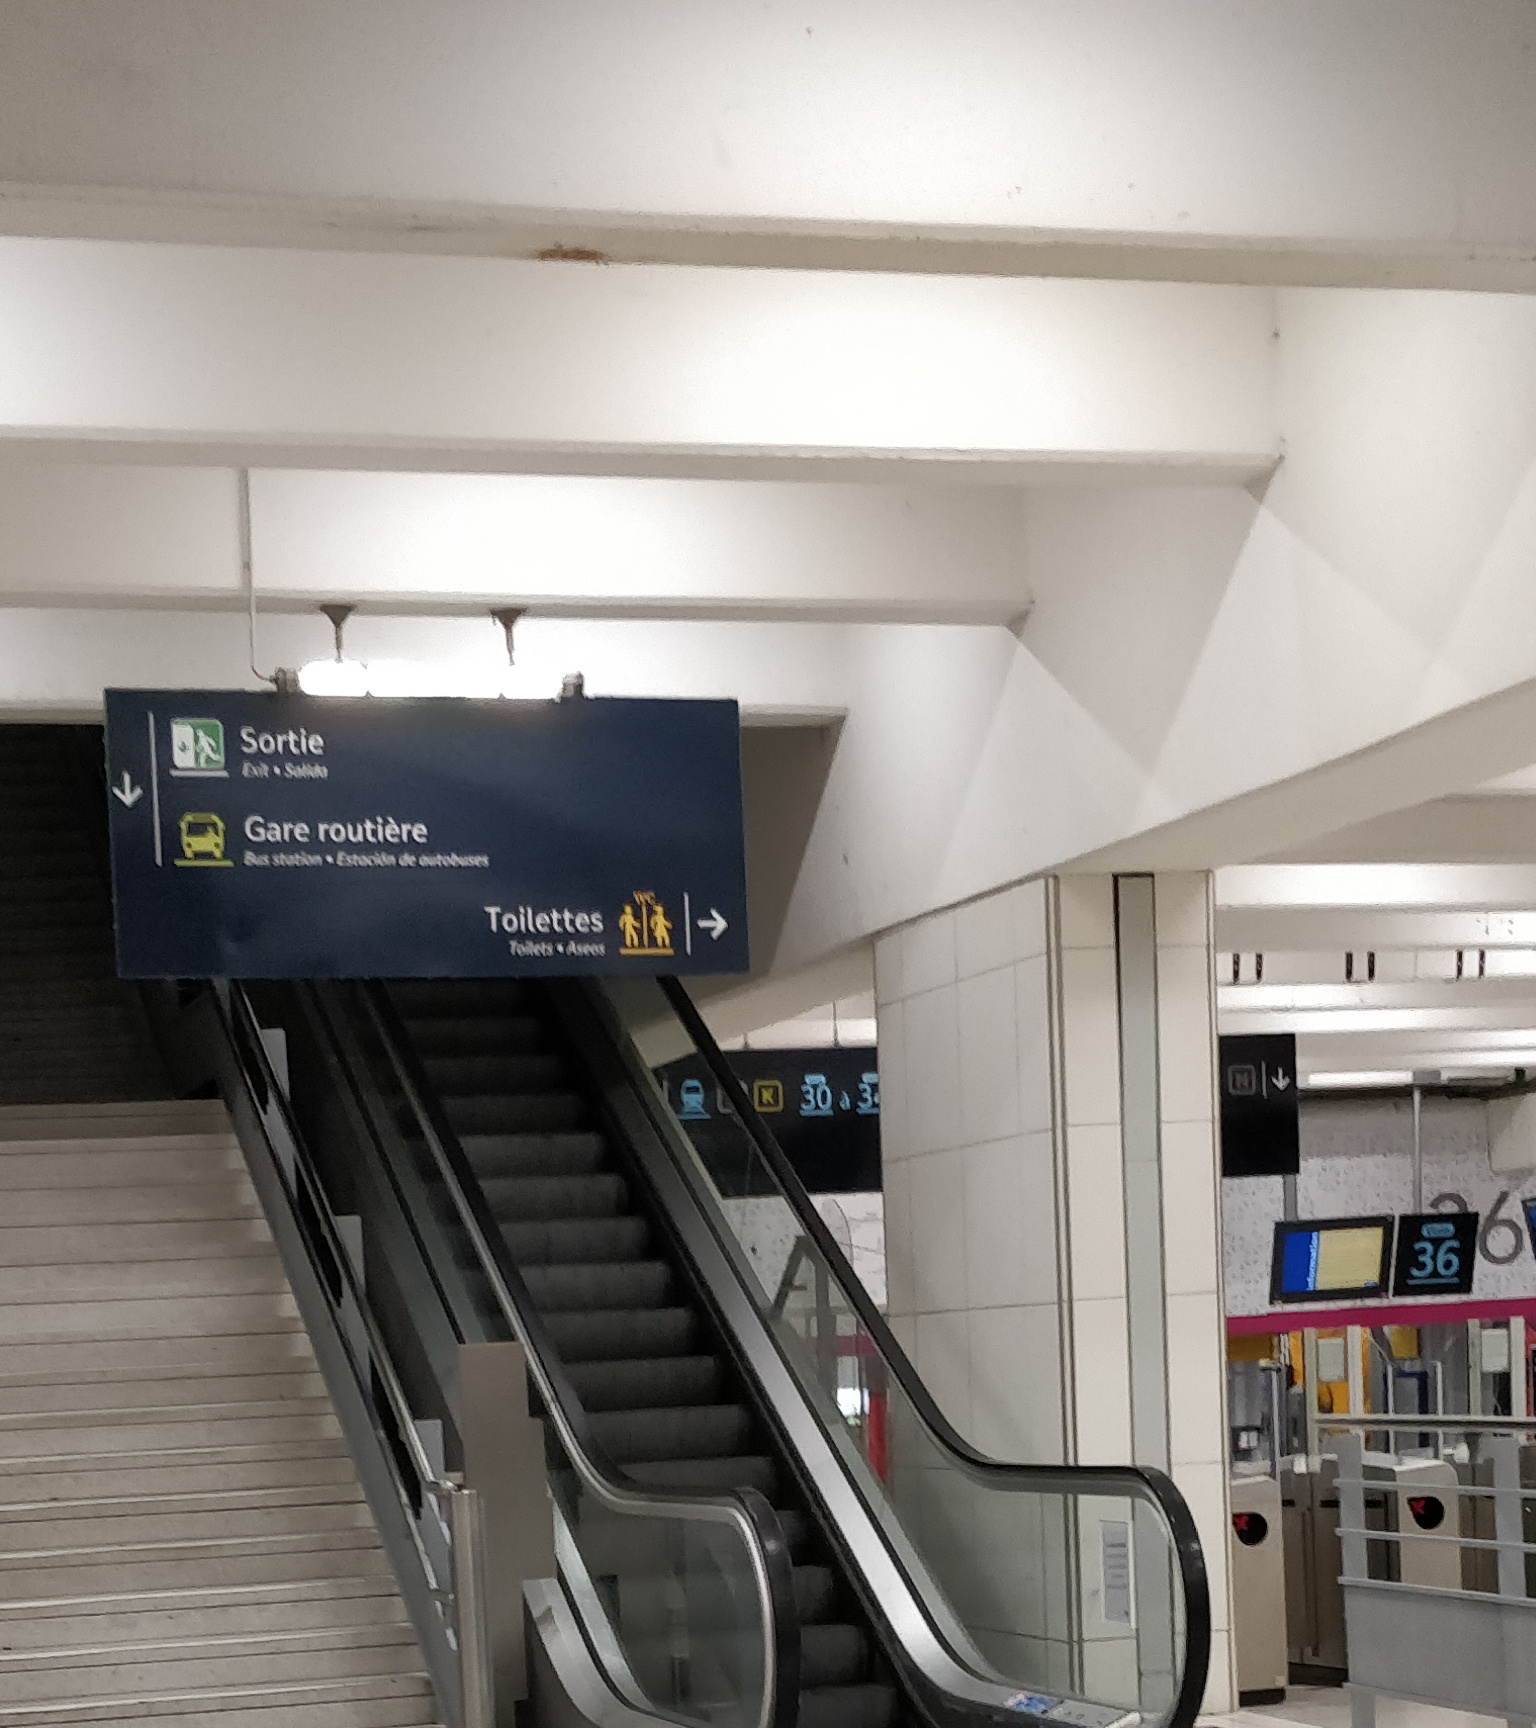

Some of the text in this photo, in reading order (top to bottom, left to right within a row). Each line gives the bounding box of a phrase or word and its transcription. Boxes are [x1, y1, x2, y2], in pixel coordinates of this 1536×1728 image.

[240, 725, 325, 755] Sortie
[244, 815, 429, 844] Gare routière
[483, 905, 604, 934] Toilettes
[800, 1082, 833, 1111] 30
[857, 1082, 880, 1111] 3
[1410, 1239, 1461, 1278] 36
